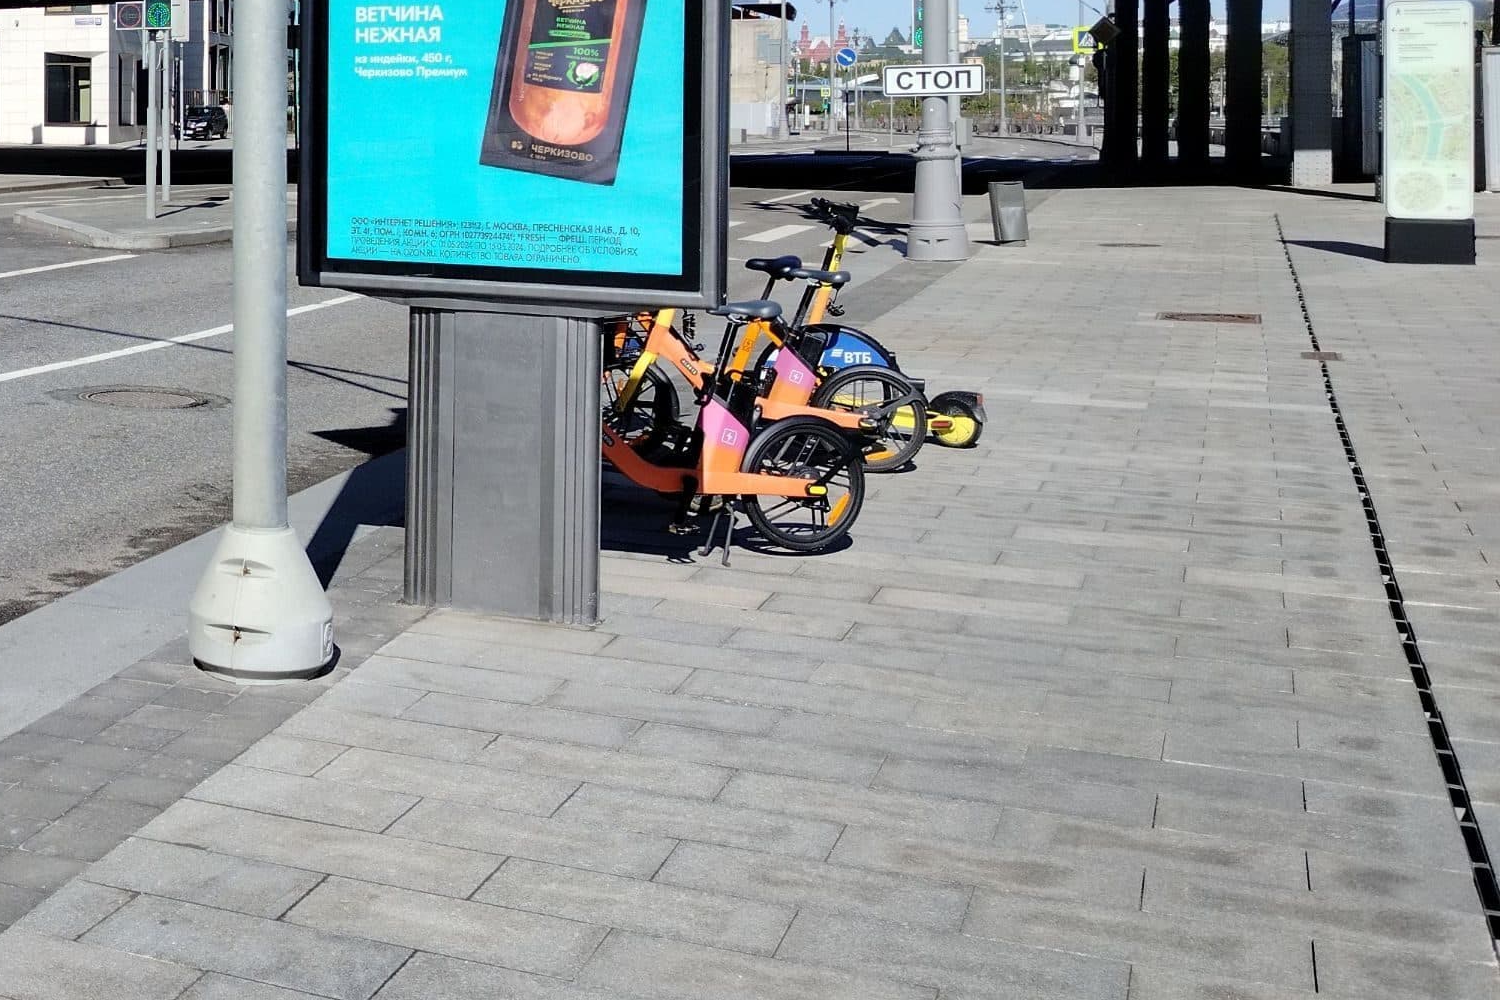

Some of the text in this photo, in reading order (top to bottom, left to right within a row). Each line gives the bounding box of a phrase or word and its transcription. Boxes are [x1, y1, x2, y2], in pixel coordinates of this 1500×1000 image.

[355, 5, 444, 22] ВЕТЧИНА
[355, 26, 441, 43] НЕЖНАЯ
[355, 56, 367, 64] из
[422, 53, 443, 63] 450
[573, 47, 599, 57] 100%
[354, 66, 468, 79] Черкизово Премиум
[896, 70, 971, 90] СТОП
[531, 143, 594, 162] ЧЕРКИЗОВО
[351, 217, 369, 225] ООО
[533, 223, 593, 234] ПРЕСНЕНСКАЯ
[439, 230, 459, 239] ОГРН
[593, 246, 638, 256] УСЛОВИЯХ
[844, 351, 872, 364] ВТБ
